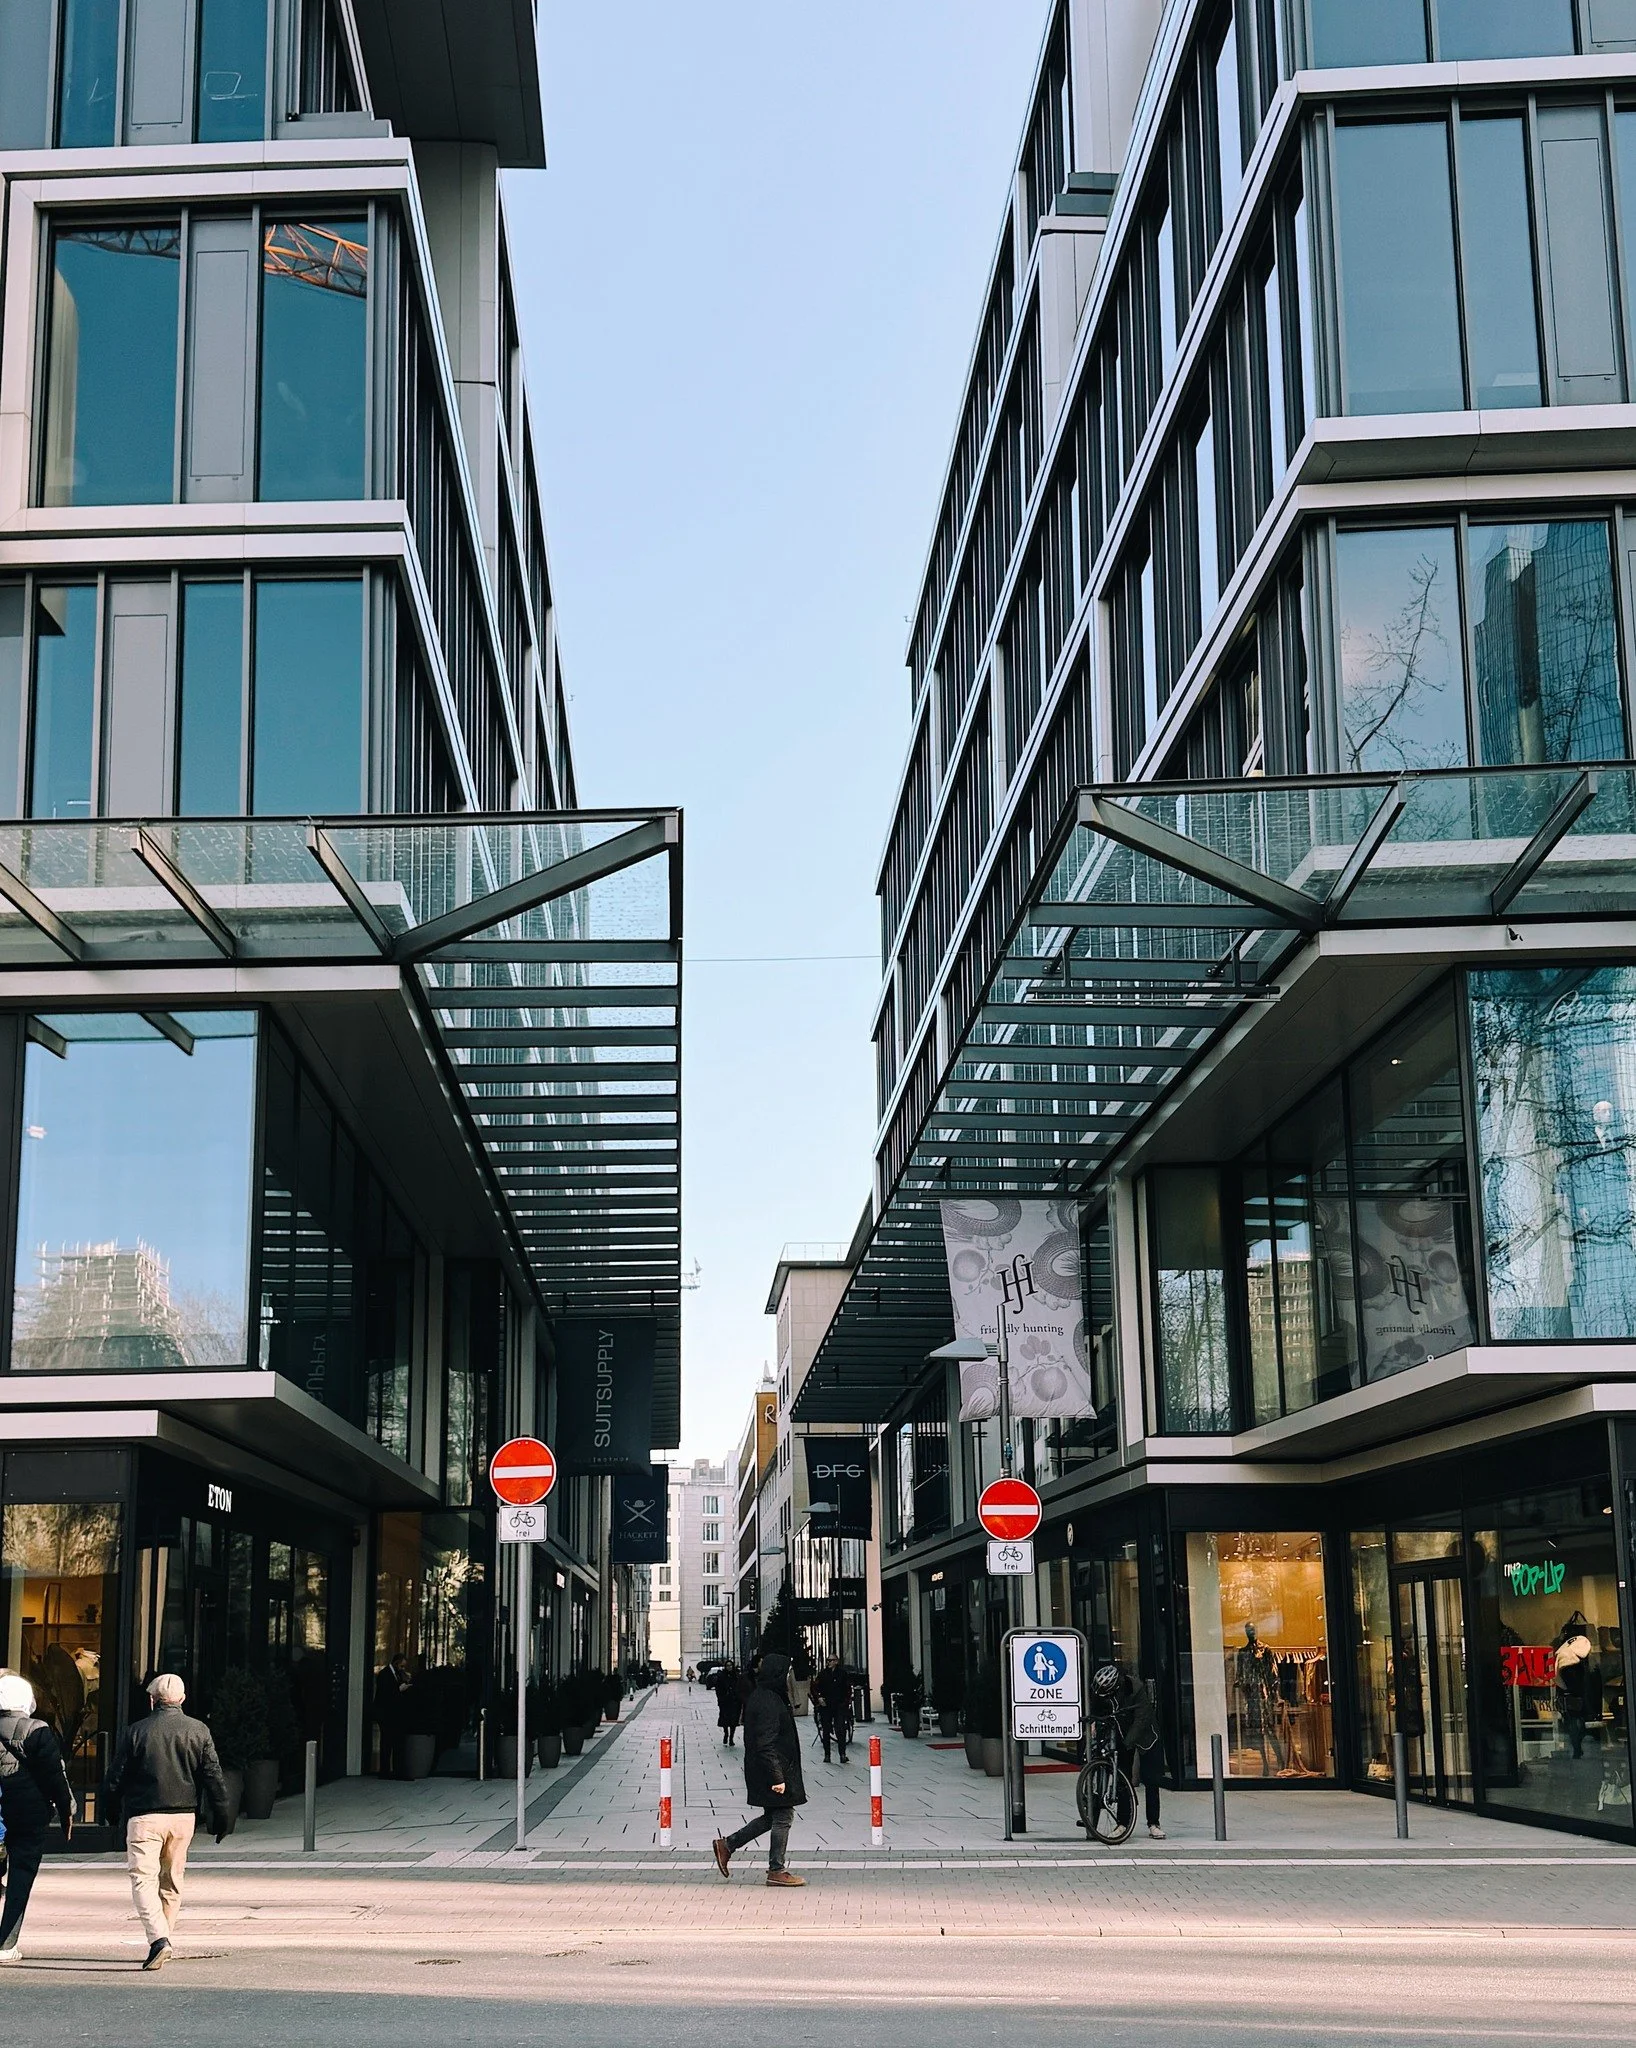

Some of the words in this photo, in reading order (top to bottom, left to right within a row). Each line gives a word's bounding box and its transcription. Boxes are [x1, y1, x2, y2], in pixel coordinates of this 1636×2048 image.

[980, 1323, 1020, 1335] friedly
[1023, 1323, 1064, 1336] hunting
[594, 1329, 614, 1448] SUITSUPPLY
[813, 1464, 865, 1479] DFG
[208, 1483, 233, 1513] ETON
[515, 1529, 530, 1538] frei
[618, 1531, 658, 1539] HACKETT
[1004, 1562, 1018, 1571] frei
[1511, 1560, 1566, 1597] POP-UP
[1029, 1688, 1063, 1700] ZONE
[1019, 1723, 1076, 1735] Schritttempo!
